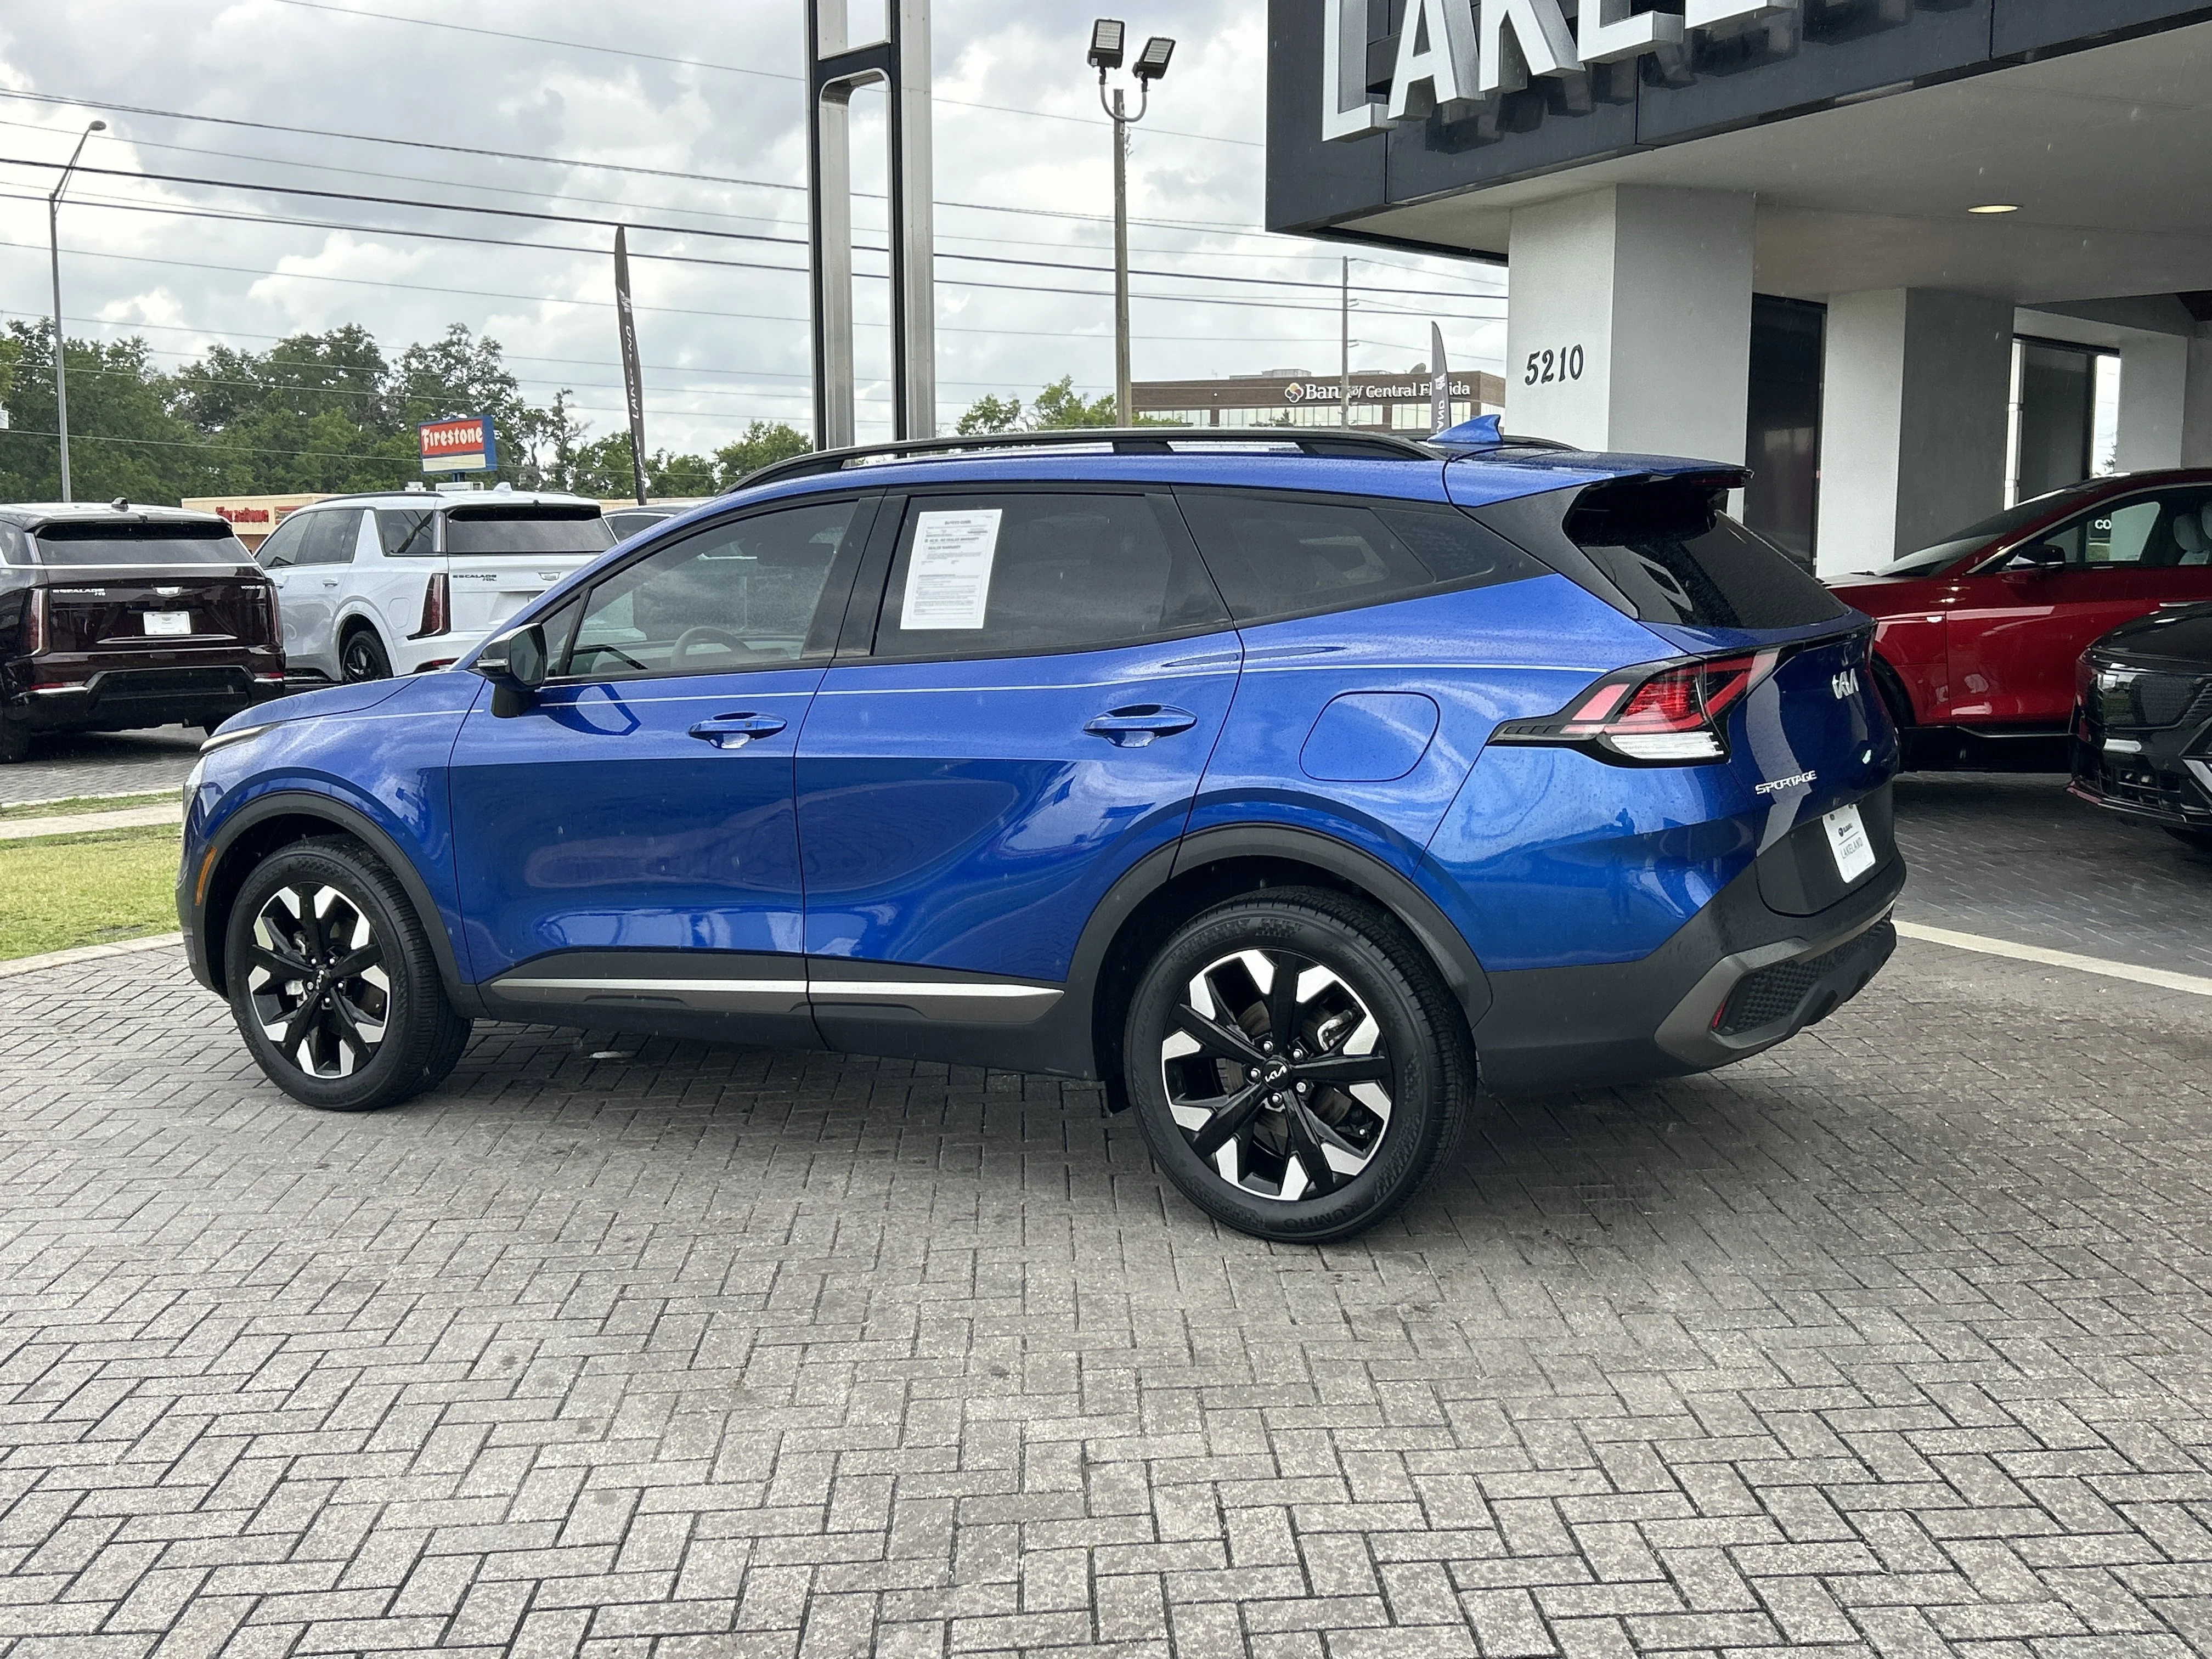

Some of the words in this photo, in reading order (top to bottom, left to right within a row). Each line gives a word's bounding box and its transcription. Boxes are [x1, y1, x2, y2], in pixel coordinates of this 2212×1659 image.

[1321, 0, 1798, 142] LAK
[624, 325, 640, 420] LAKAND
[1525, 344, 1583, 385] 5210
[1353, 385, 1364, 398] of
[1365, 382, 1417, 398] Central
[1419, 381, 1471, 397] Flida
[421, 427, 483, 452] Firestone
[2095, 519, 2112, 530] CO
[1832, 668, 1859, 699] KIA
[1755, 770, 1818, 795] SPORTAGE
[1265, 1065, 1287, 1082] KIA
